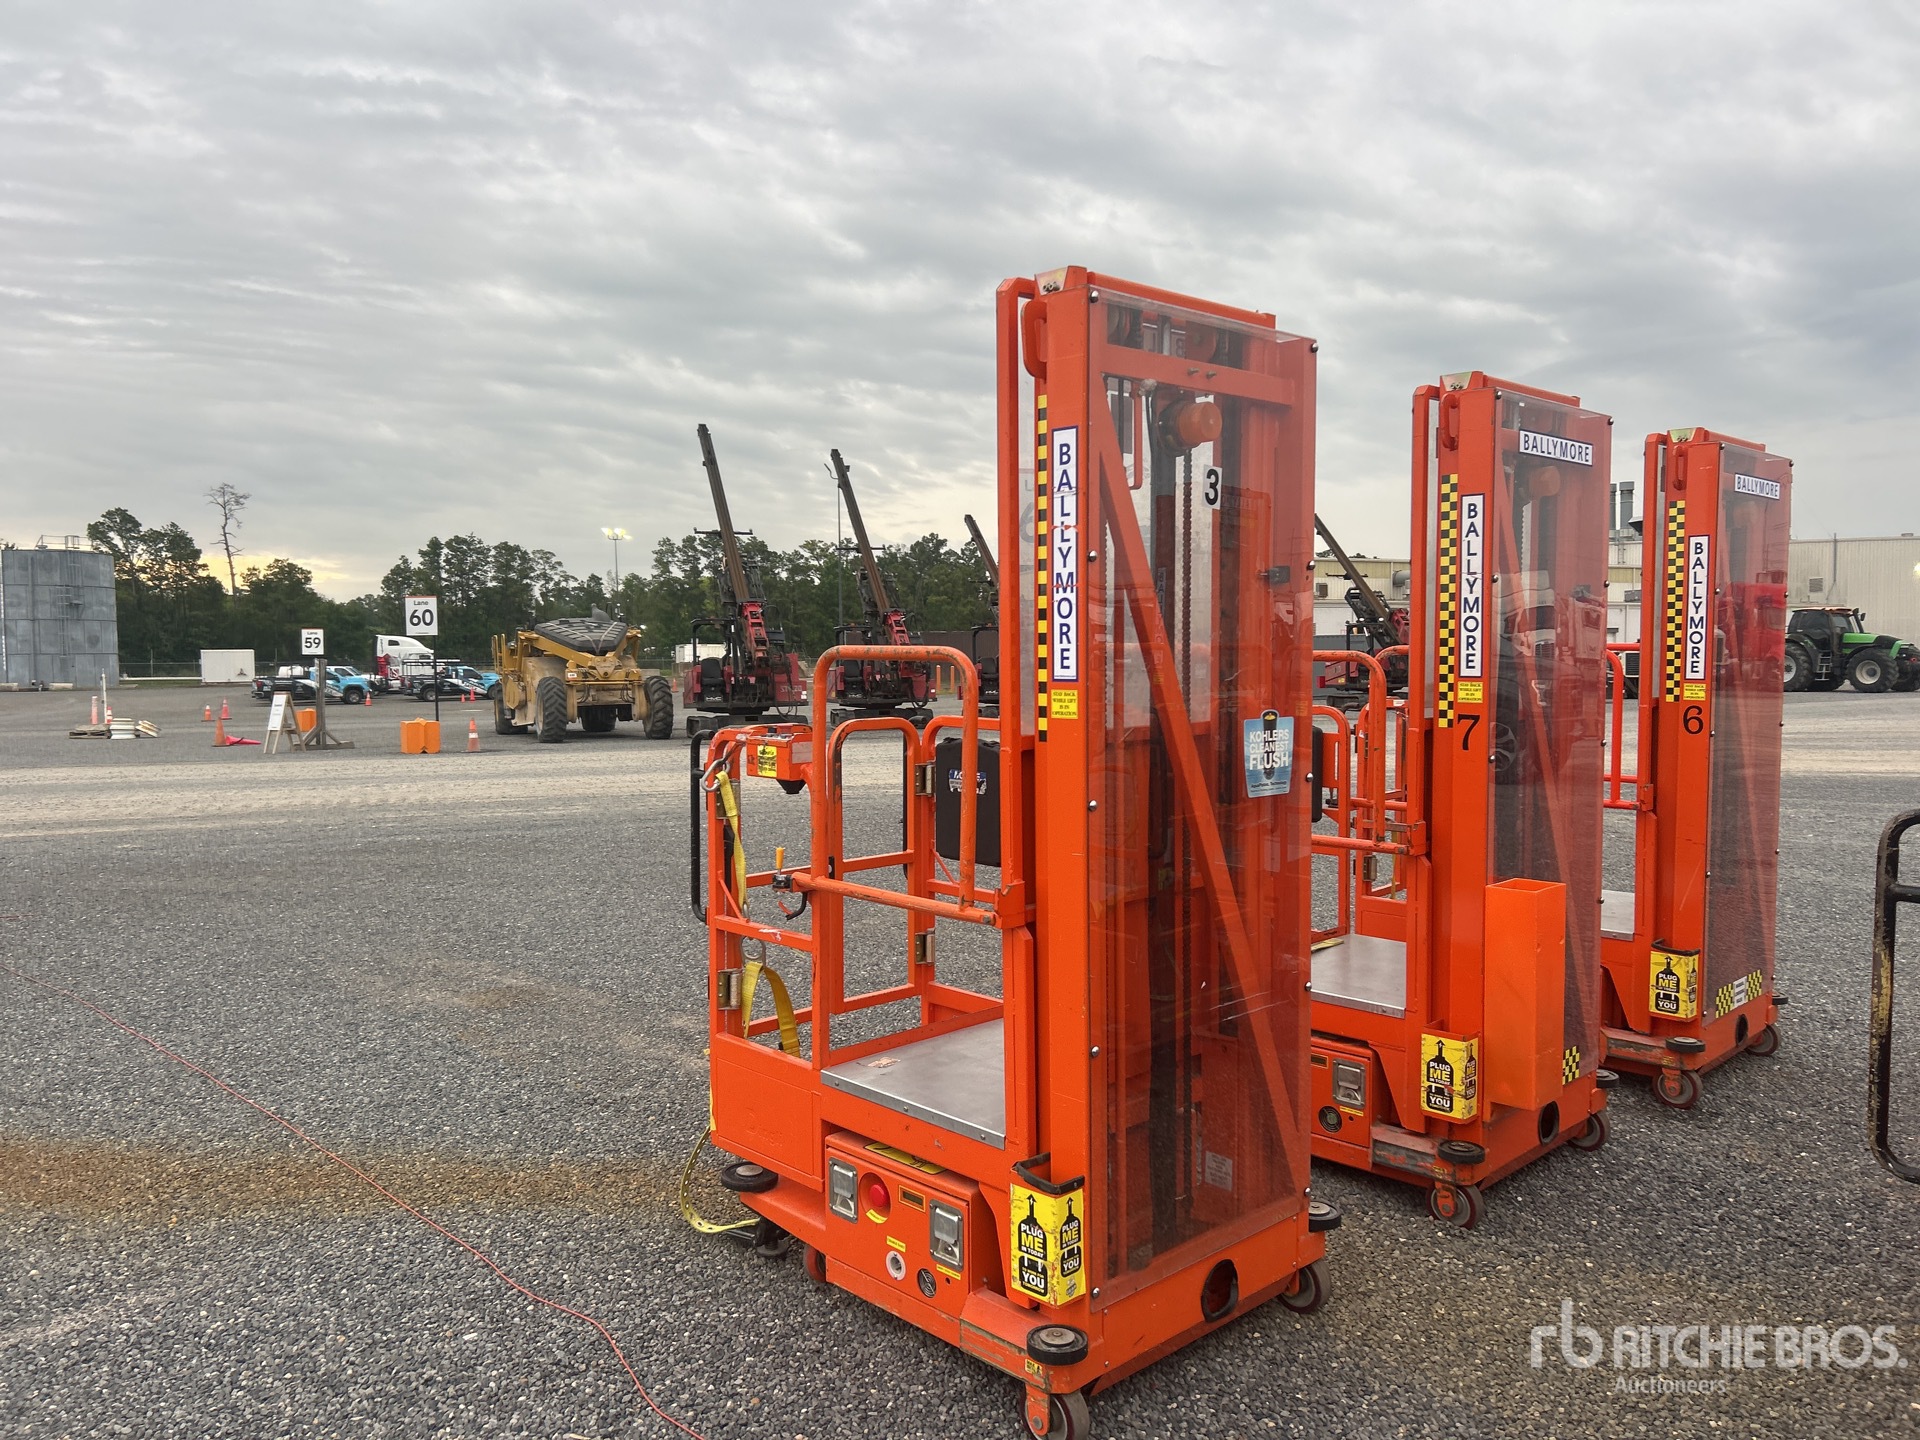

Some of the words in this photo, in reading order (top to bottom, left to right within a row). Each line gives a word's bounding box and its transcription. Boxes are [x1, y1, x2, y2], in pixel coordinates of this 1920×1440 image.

[1523, 433, 1589, 462] BALLYMORE
[1205, 468, 1219, 506] 3
[1737, 476, 1779, 497] BALLYMORE
[1056, 443, 1074, 669] BALLYMORE
[1463, 502, 1480, 669] BALLYMORE
[1689, 542, 1705, 674] BALLYMORE
[409, 608, 434, 627] 60
[304, 637, 322, 649] 59
[1683, 705, 1704, 735] 6
[1249, 729, 1290, 743] KOHLERS
[1457, 714, 1480, 751] 7
[1249, 741, 1289, 754] CLEANEST
[1249, 751, 1289, 770] FLUSH
[1658, 973, 1678, 981] PLUG
[1658, 979, 1677, 989] ME
[1658, 1001, 1677, 1010] YOU
[1429, 1062, 1450, 1072] PLUG
[1429, 1068, 1450, 1082] ME
[1430, 1095, 1450, 1108] YOU
[1021, 1223, 1043, 1239] PLUG
[1062, 1220, 1079, 1233] PLUG
[1021, 1233, 1044, 1252] ME
[1062, 1227, 1079, 1244] ME
[1028, 1248, 1044, 1258] TODAY
[1063, 1257, 1080, 1272] YOU
[1022, 1270, 1044, 1289] YOU
